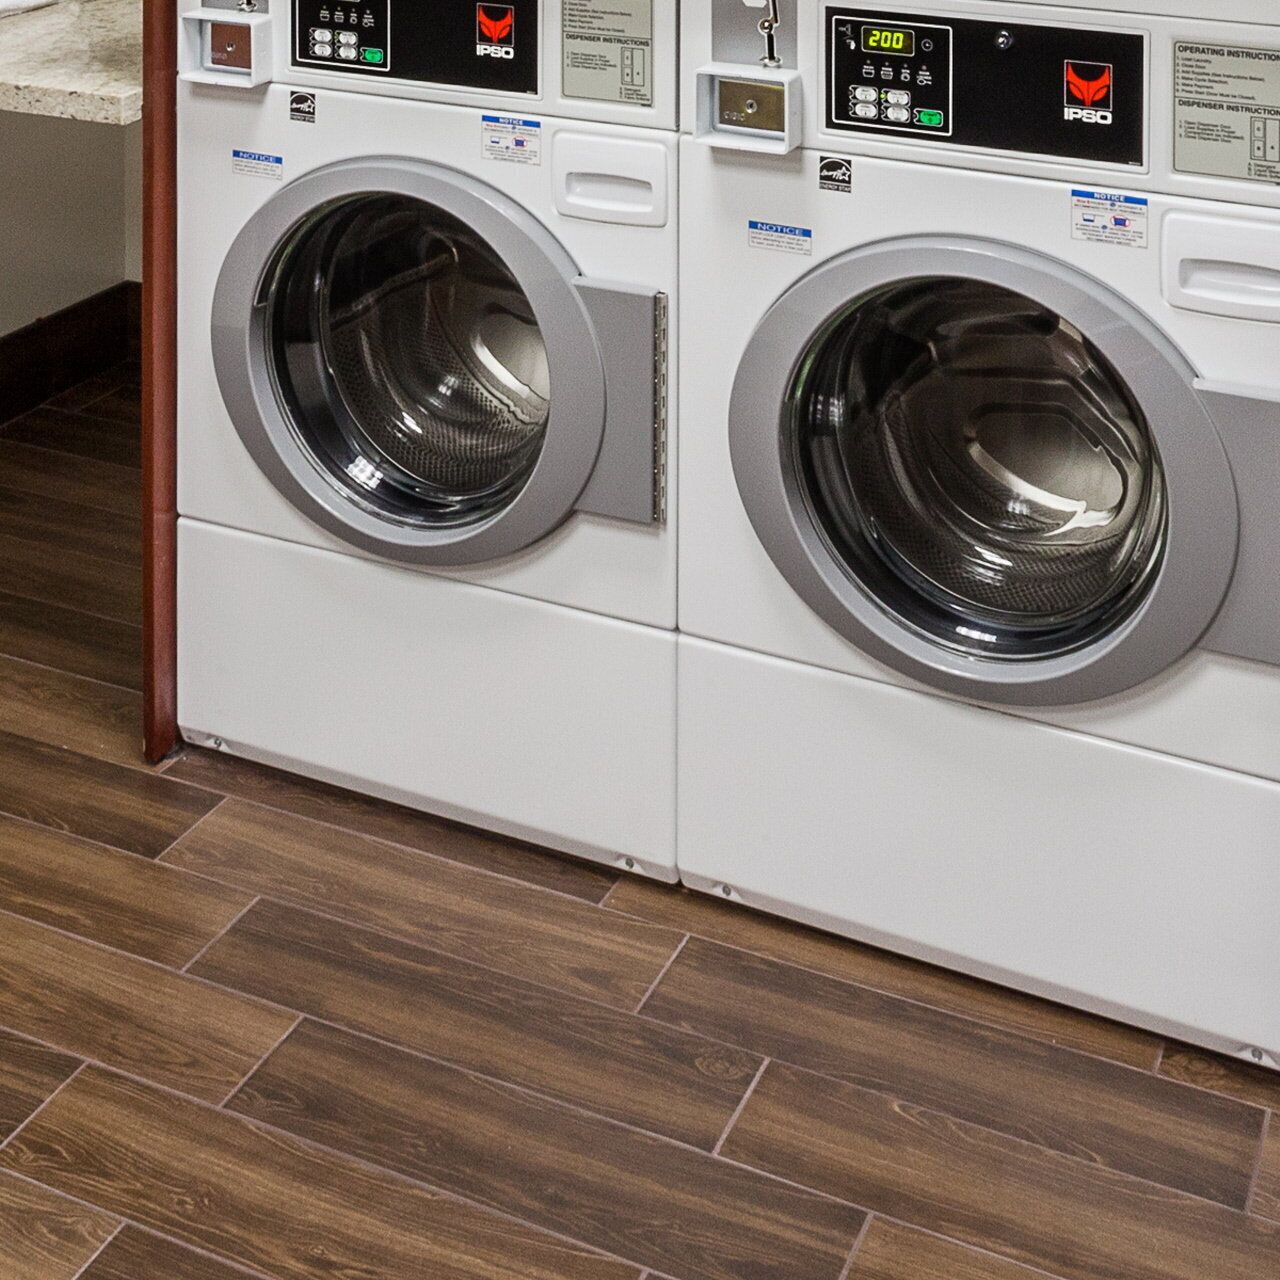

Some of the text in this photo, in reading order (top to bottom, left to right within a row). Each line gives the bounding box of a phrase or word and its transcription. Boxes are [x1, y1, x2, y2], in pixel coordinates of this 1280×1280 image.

[565, 33, 649, 46] DISPENSER INSTRUCTIONS
[868, 30, 904, 49] 200
[476, 44, 514, 59] IPSO
[1178, 45, 1225, 57] OPERATING
[1178, 99, 1224, 111] DISPENSER
[1064, 107, 1112, 125] IPSO
[240, 152, 277, 163] NOTICE
[1094, 193, 1125, 202] NOTICE
[757, 223, 803, 236] NOTICE
